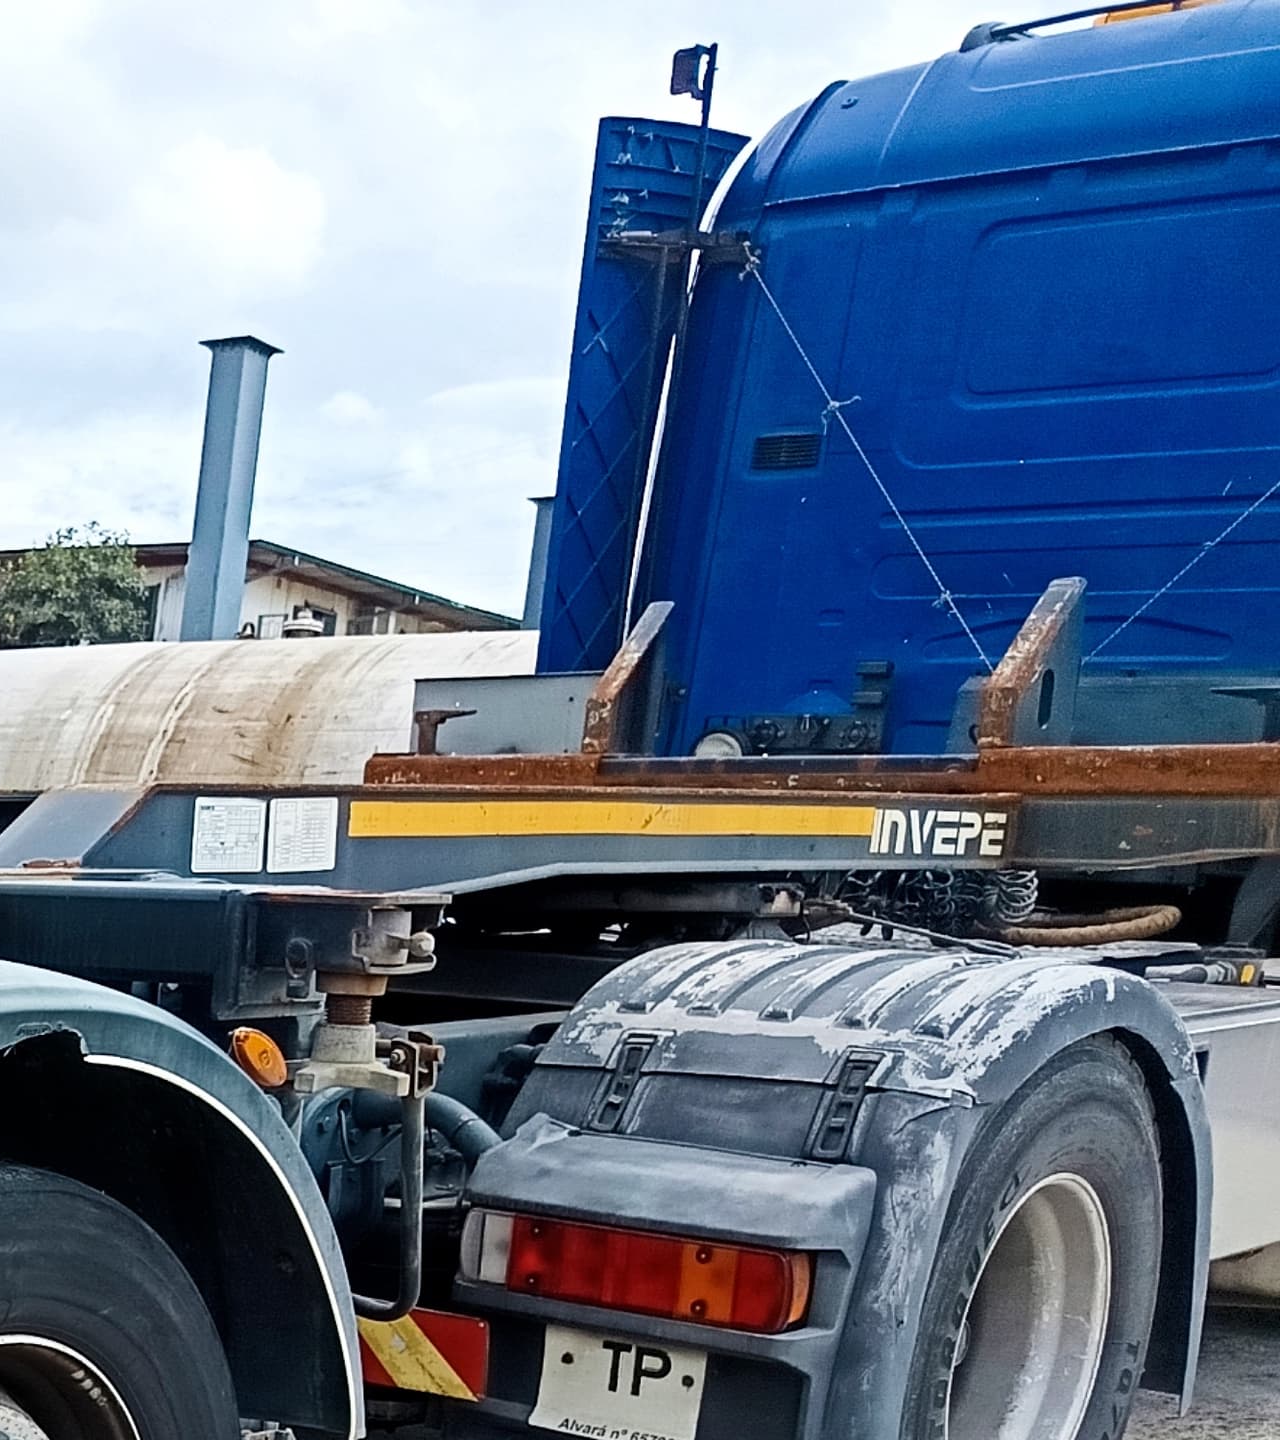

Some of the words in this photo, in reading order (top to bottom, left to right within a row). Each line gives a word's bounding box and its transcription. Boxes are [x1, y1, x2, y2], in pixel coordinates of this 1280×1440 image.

[869, 808, 1008, 856] INVEPE
[602, 1340, 672, 1396] TP
[558, 1417, 607, 1440] Alvará
